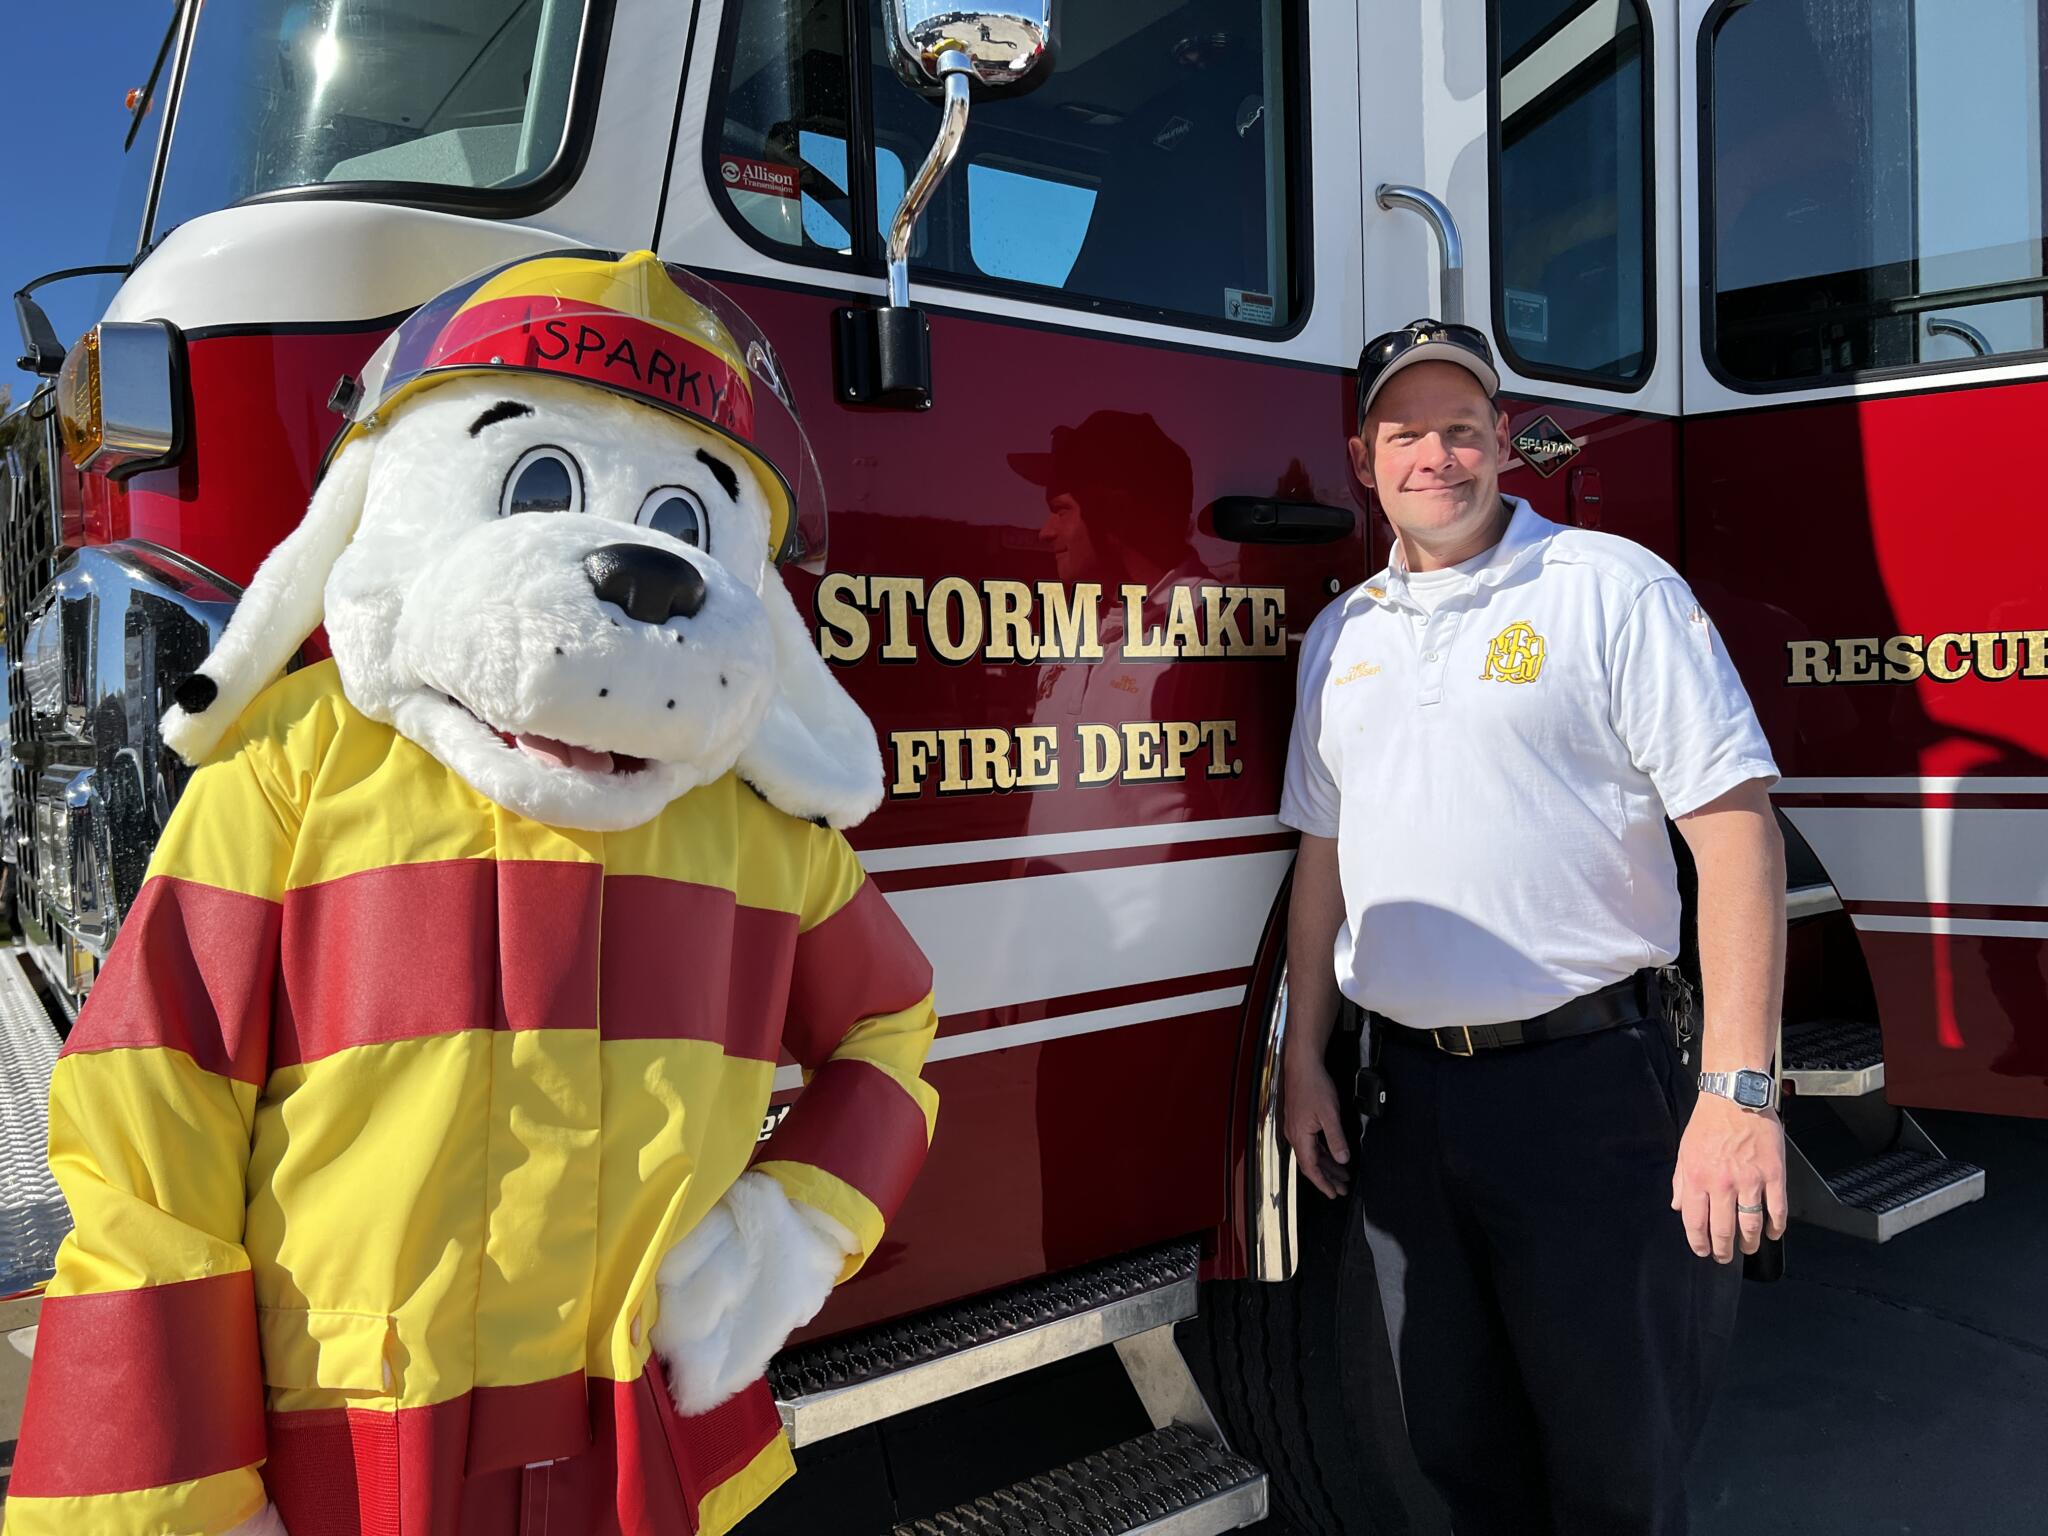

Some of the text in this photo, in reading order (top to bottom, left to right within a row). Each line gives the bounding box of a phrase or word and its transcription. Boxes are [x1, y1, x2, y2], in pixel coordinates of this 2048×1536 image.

[742, 164, 793, 186] Allison
[743, 178, 794, 194] Transmission
[536, 320, 724, 418] SPARKY
[1519, 437, 1573, 456] SPARTAN
[818, 573, 1287, 662] STORM LAKE
[890, 720, 1243, 795] FIRE DEPT.
